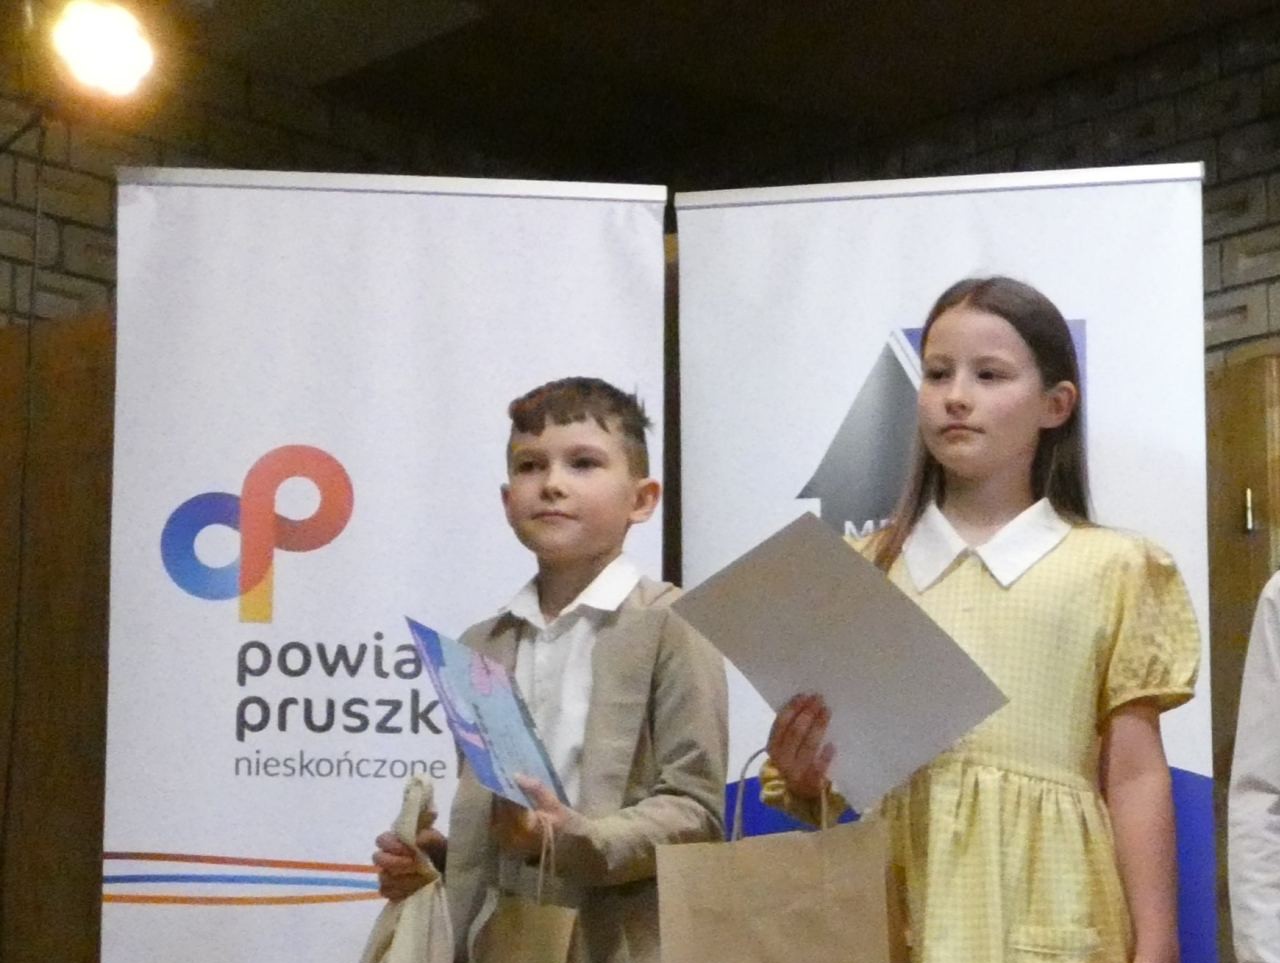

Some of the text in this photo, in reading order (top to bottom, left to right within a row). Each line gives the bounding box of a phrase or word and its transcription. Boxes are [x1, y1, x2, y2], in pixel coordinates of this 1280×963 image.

[237, 631, 423, 687] powia
[235, 688, 443, 742] pruszk
[234, 749, 447, 780] nieskończone
